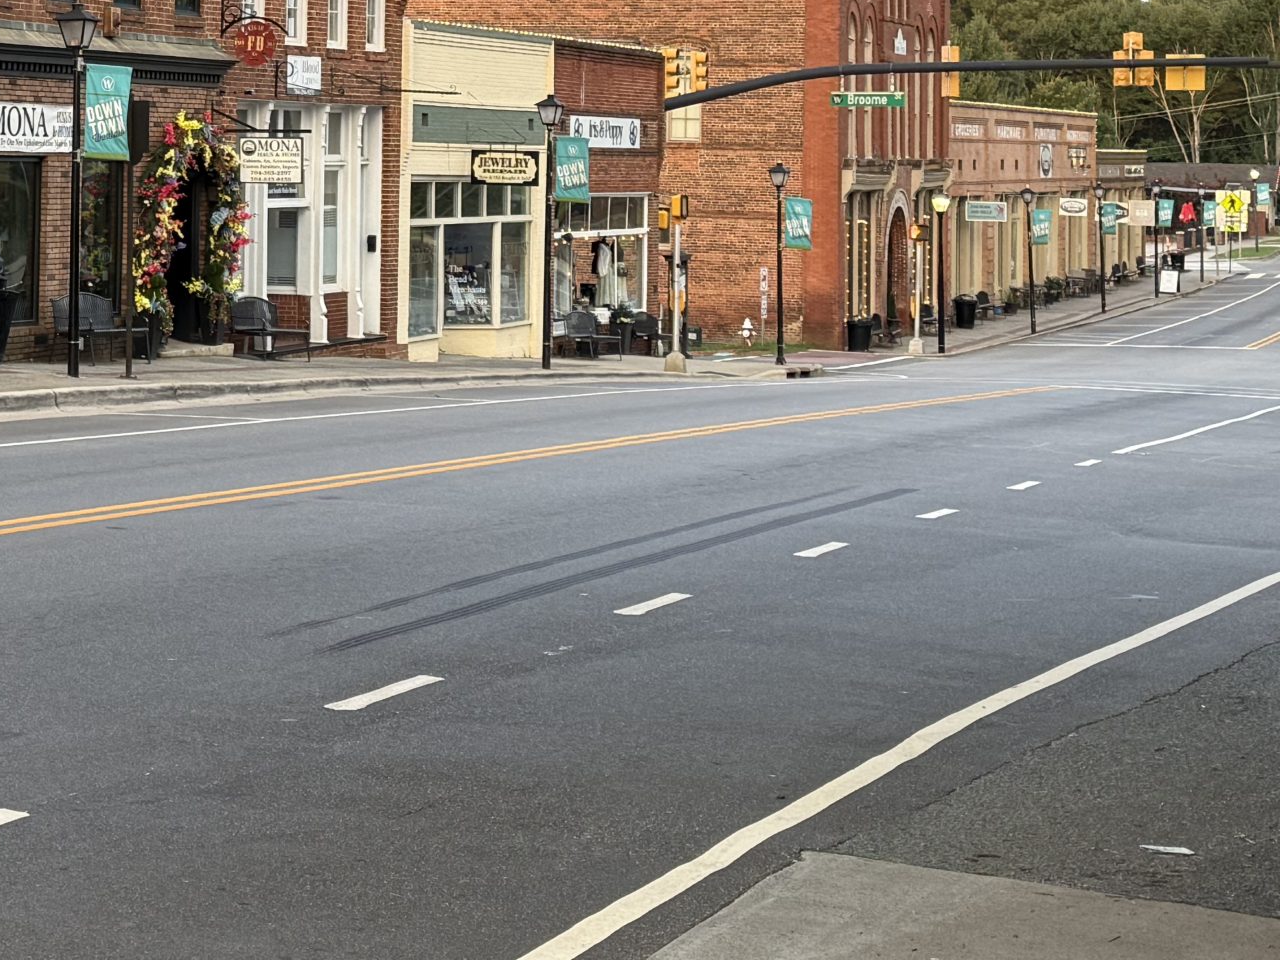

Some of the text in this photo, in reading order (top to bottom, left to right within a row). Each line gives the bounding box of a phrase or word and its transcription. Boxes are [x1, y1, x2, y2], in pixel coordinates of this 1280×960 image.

[847, 94, 888, 105] Broome
[86, 99, 123, 123] DOWN
[88, 116, 125, 136] TOWN
[258, 139, 300, 152] MONA
[478, 156, 530, 168] JEWELRY
[556, 158, 586, 177] DOWN
[559, 172, 588, 188] TOWN
